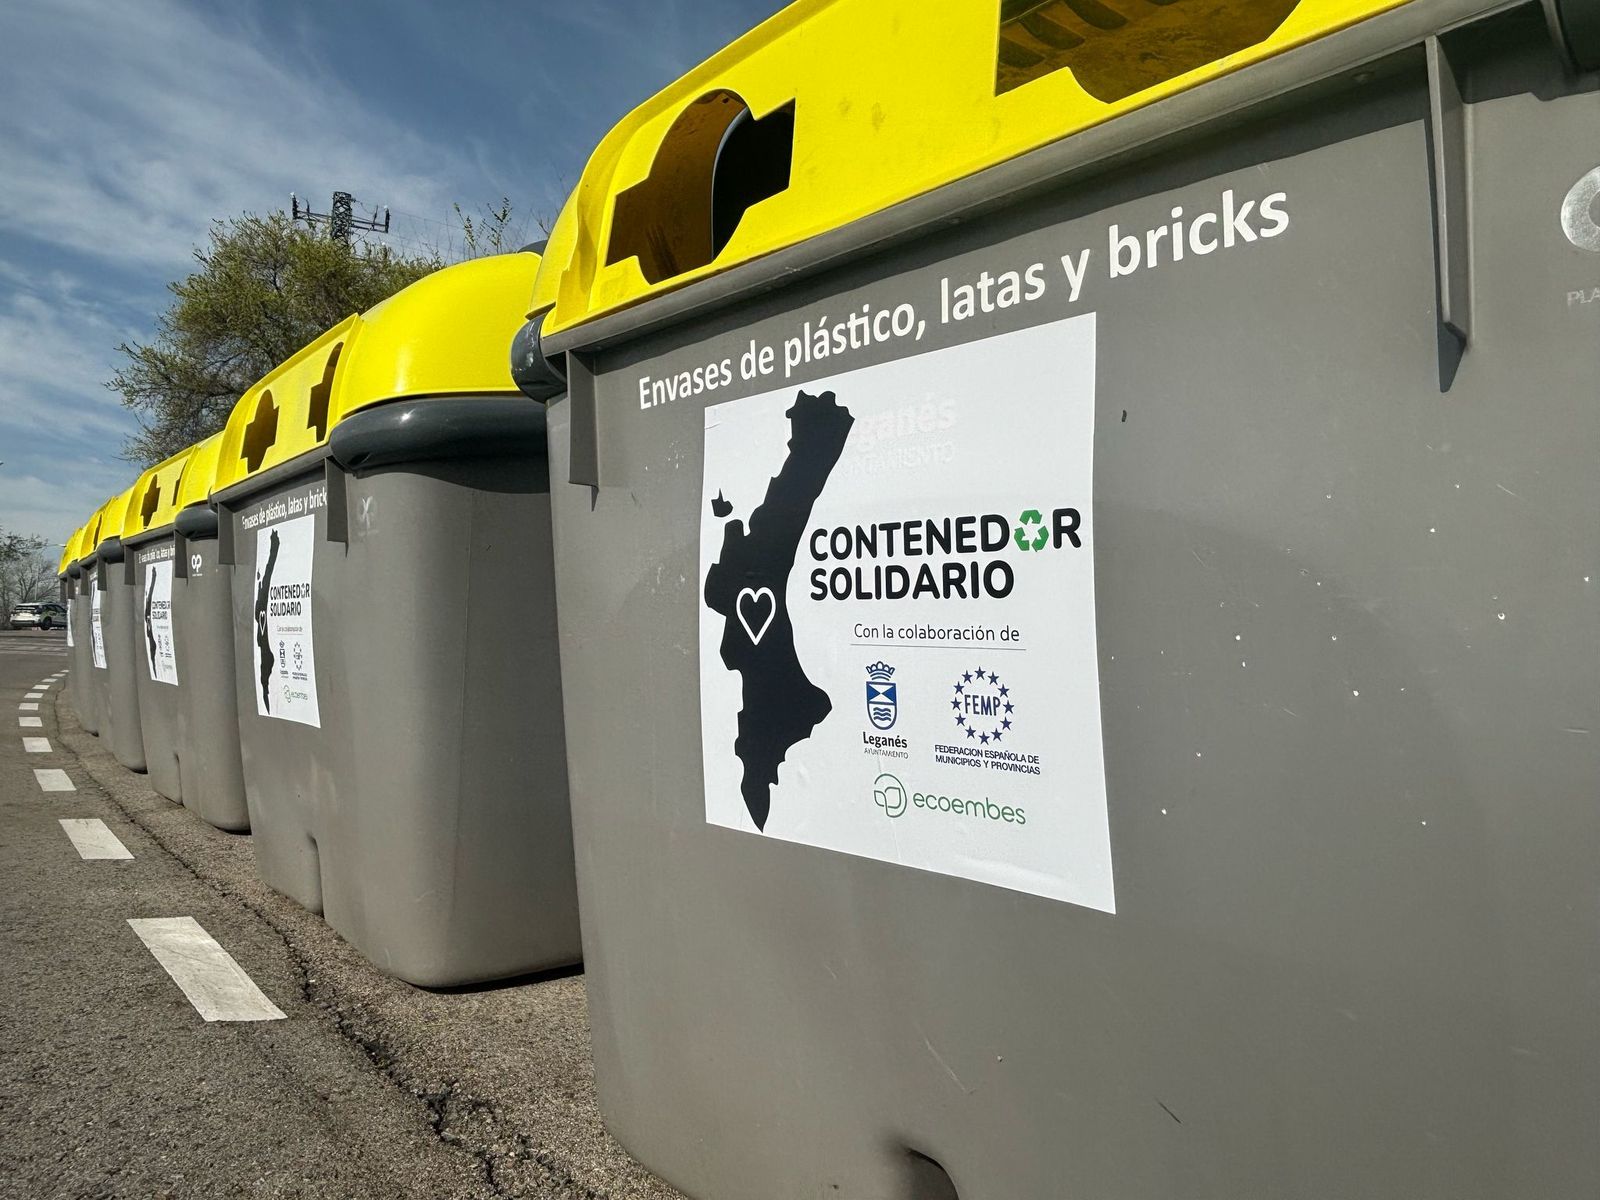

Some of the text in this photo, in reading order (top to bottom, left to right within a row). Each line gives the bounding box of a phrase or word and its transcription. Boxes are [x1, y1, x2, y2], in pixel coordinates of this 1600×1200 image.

[639, 189, 1290, 410] Envases de plástico, latas y bricks
[309, 486, 328, 509] brick
[810, 559, 1015, 601] SOLIDARIO
[270, 601, 301, 617] SOLIDARIO
[854, 623, 1020, 642] Con la colaboración de
[964, 694, 1001, 717] FEMP
[862, 731, 908, 749] Leganés
[864, 747, 909, 759] AYUNTAMIENTO
[934, 744, 1040, 765] FEDERACION ESPAÑOLA DE
[935, 754, 1041, 775] MUNICIPIOS Y PROVINCIAS
[913, 792, 1026, 825] ecoembes
